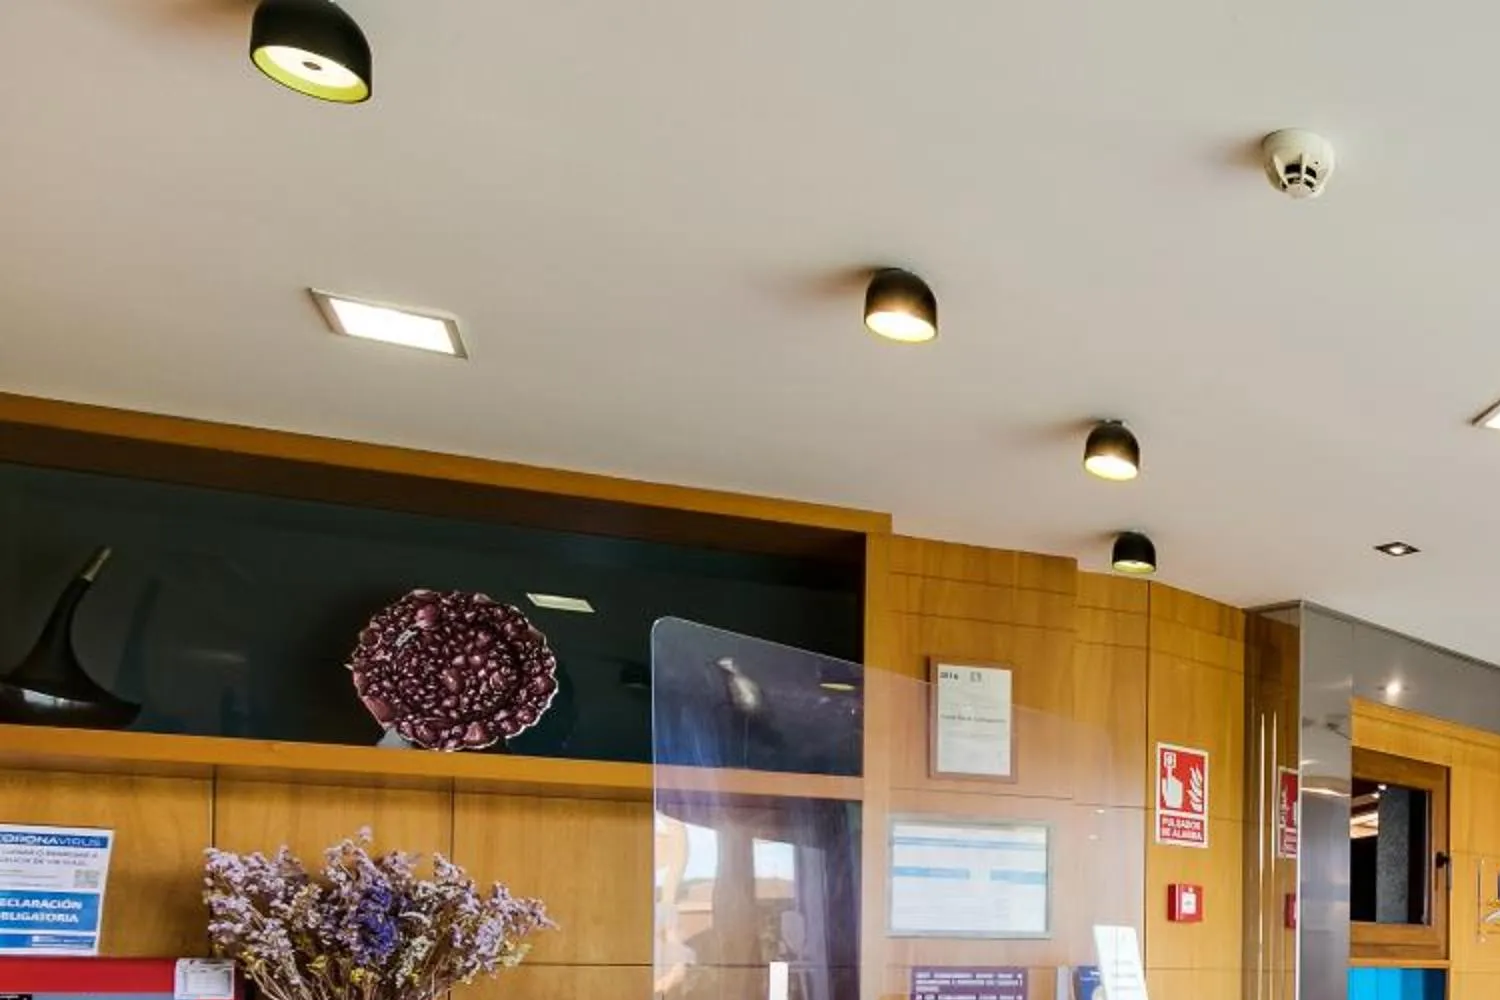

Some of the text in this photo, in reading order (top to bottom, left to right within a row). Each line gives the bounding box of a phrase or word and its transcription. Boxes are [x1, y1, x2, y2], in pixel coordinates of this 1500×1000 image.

[1161, 815, 1201, 830] PULSADOR
[0, 833, 101, 848] ORONAVIRUS
[0, 911, 79, 923] BLIGATORIA
